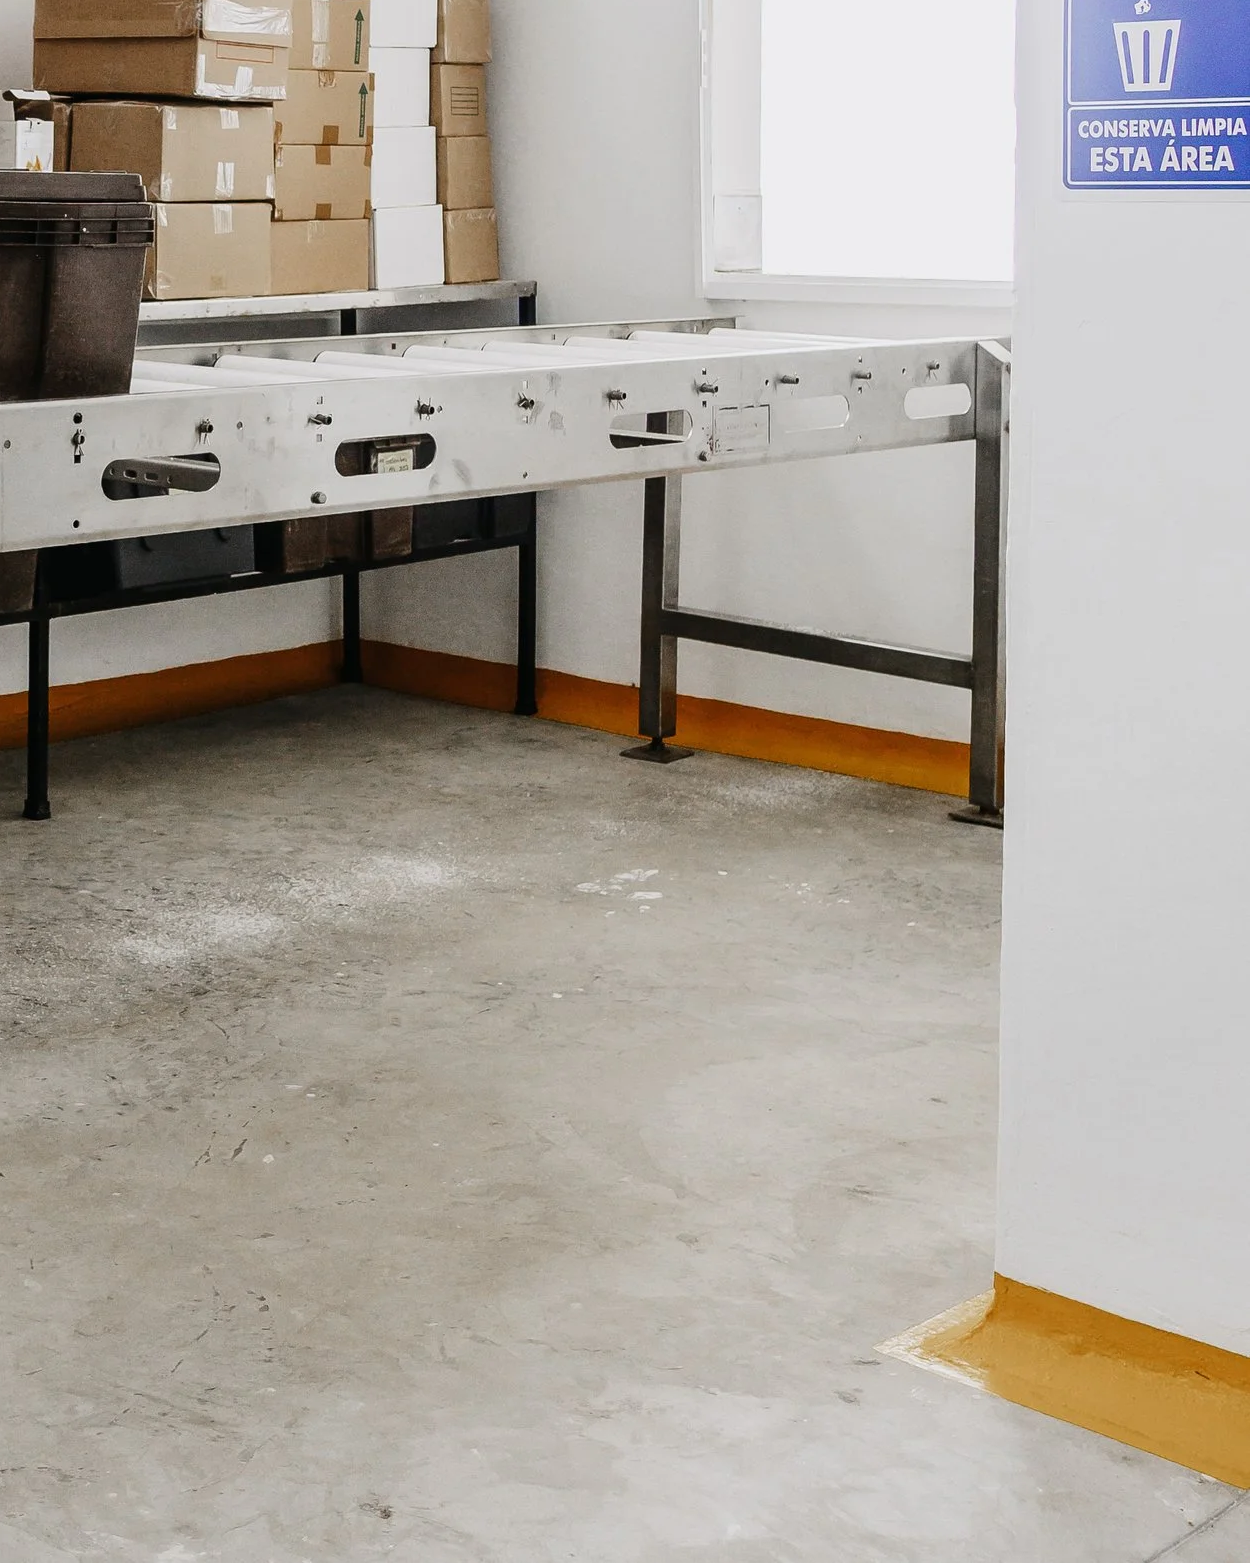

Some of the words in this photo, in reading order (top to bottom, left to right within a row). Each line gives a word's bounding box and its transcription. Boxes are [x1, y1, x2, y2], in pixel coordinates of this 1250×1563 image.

[1078, 119, 1176, 138] CONSERVA
[1181, 117, 1247, 136] LIMPIA
[1090, 146, 1153, 172] ESTA
[1160, 139, 1235, 172] ÁREA
